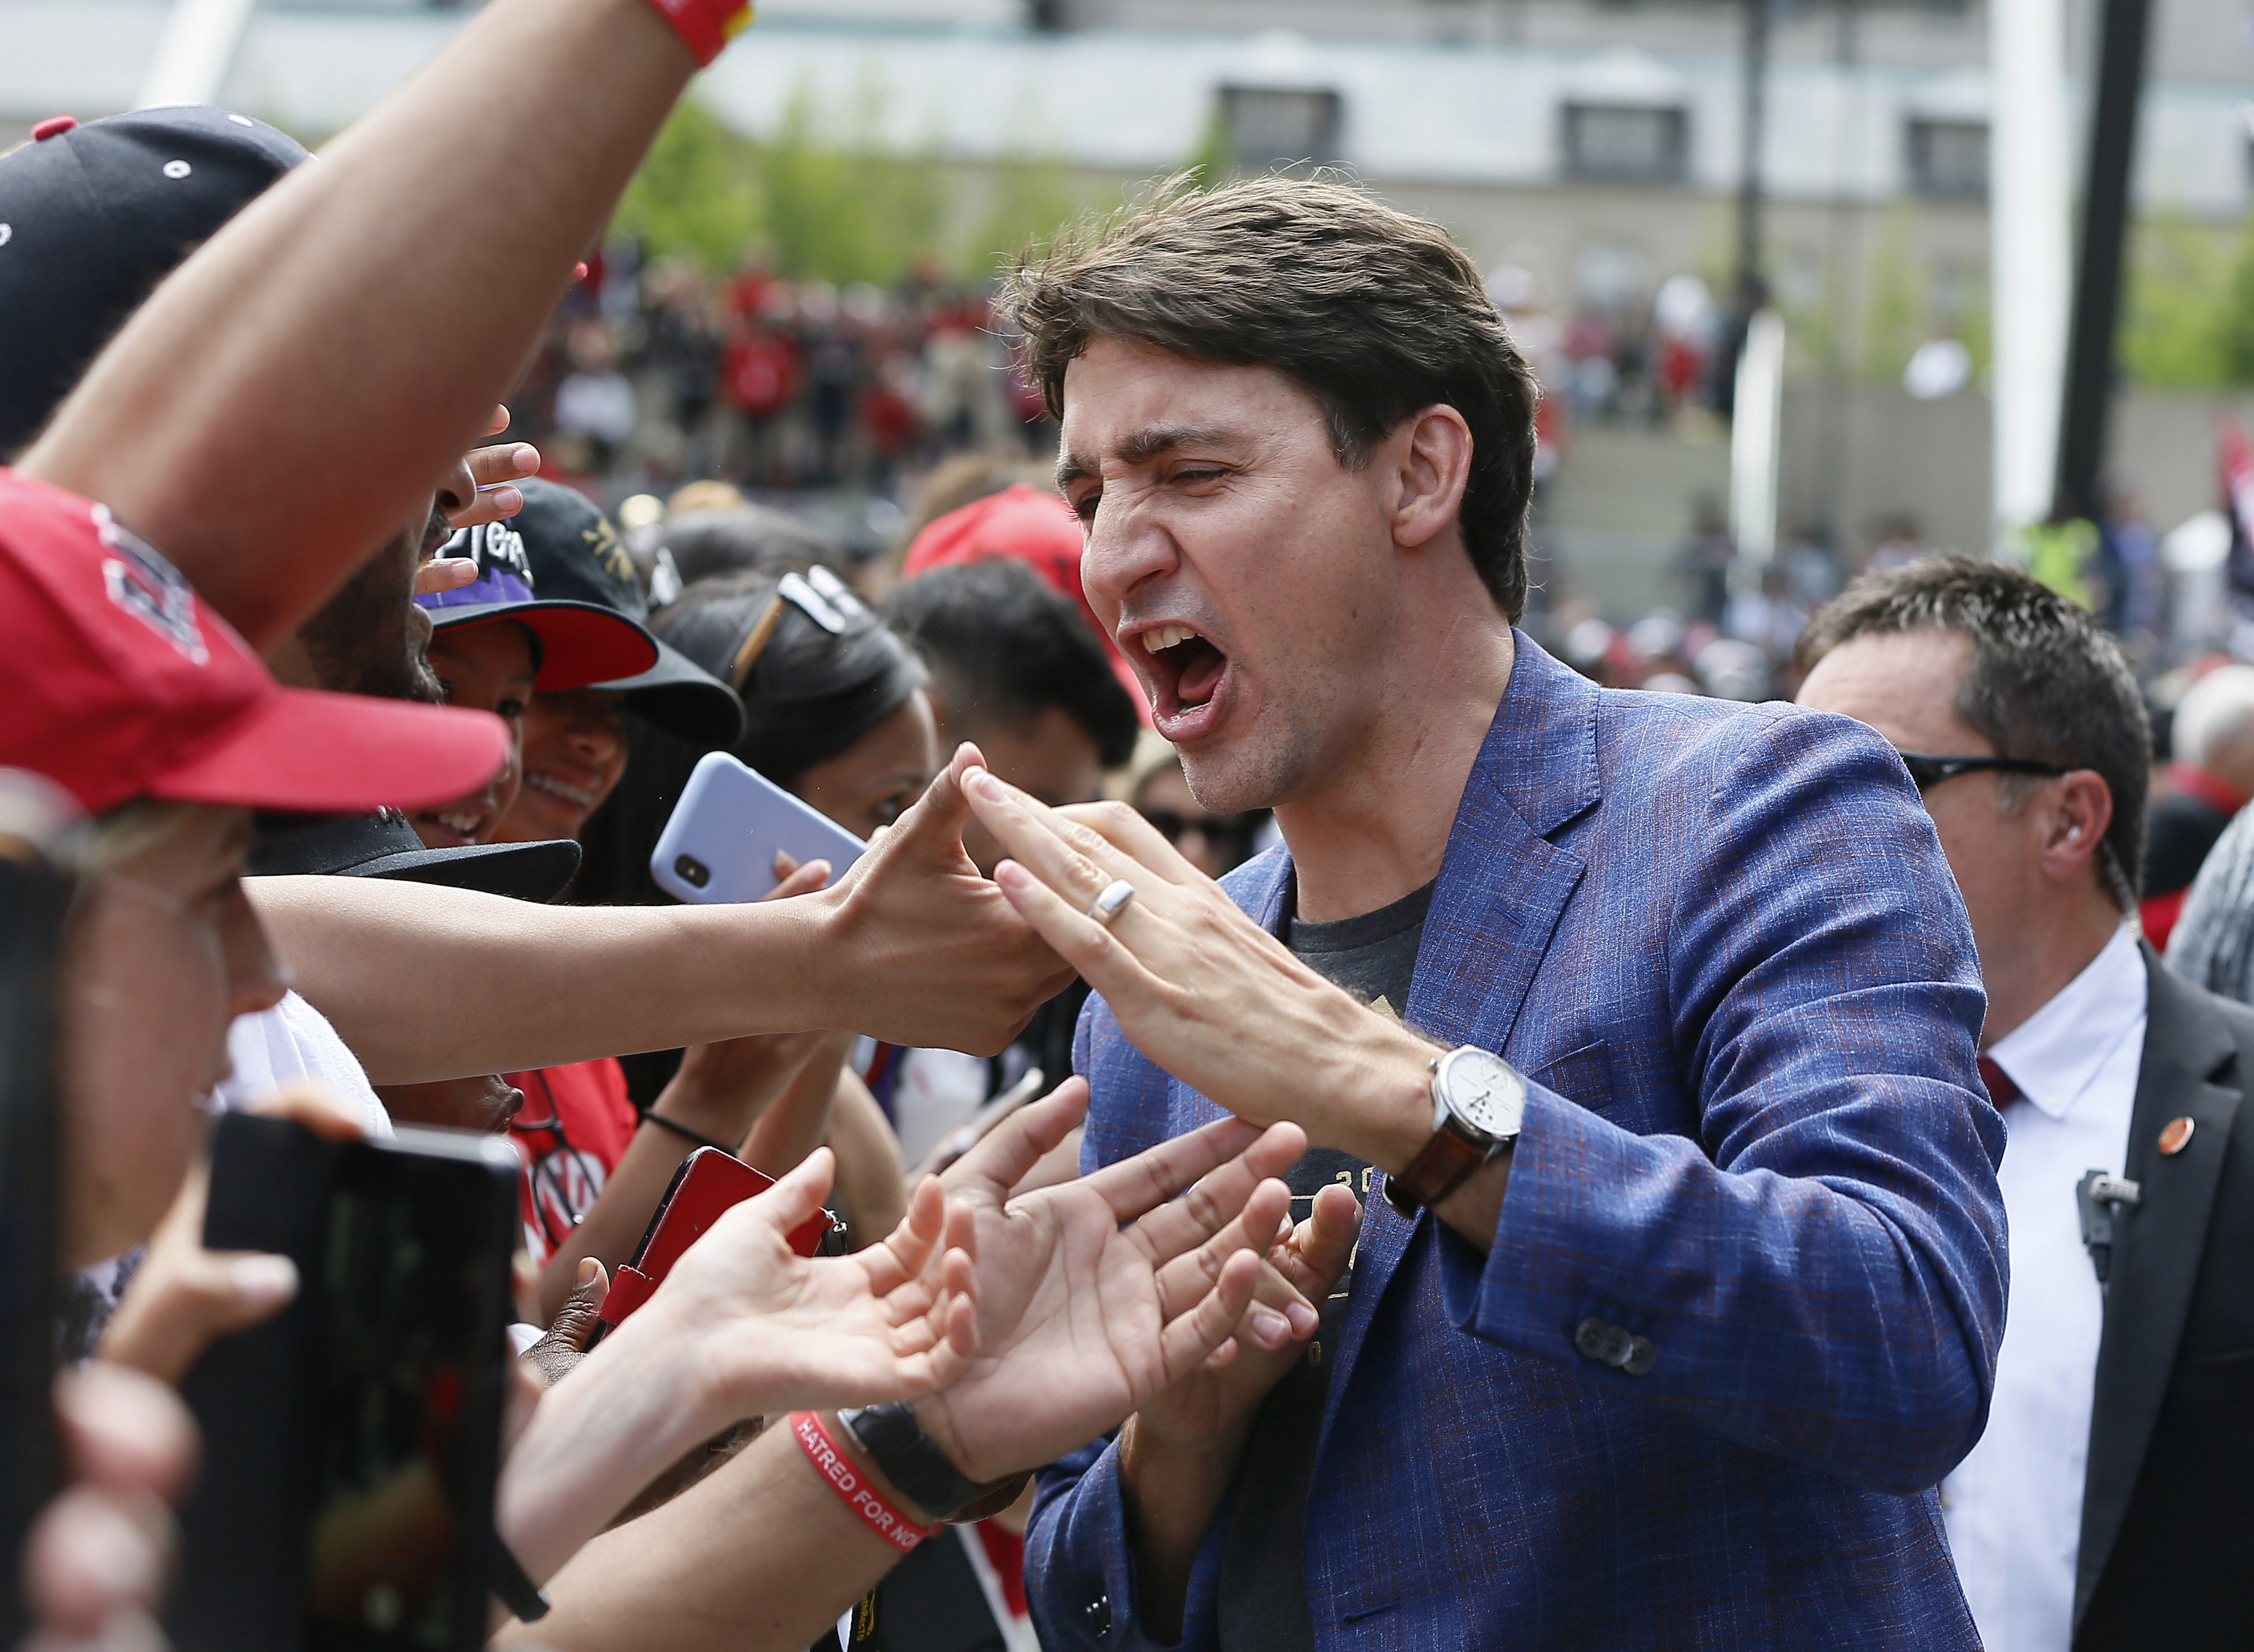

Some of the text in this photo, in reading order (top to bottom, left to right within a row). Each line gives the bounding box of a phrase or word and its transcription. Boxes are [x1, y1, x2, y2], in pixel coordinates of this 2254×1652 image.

[797, 1418, 921, 1547] HATRED FOR NO
